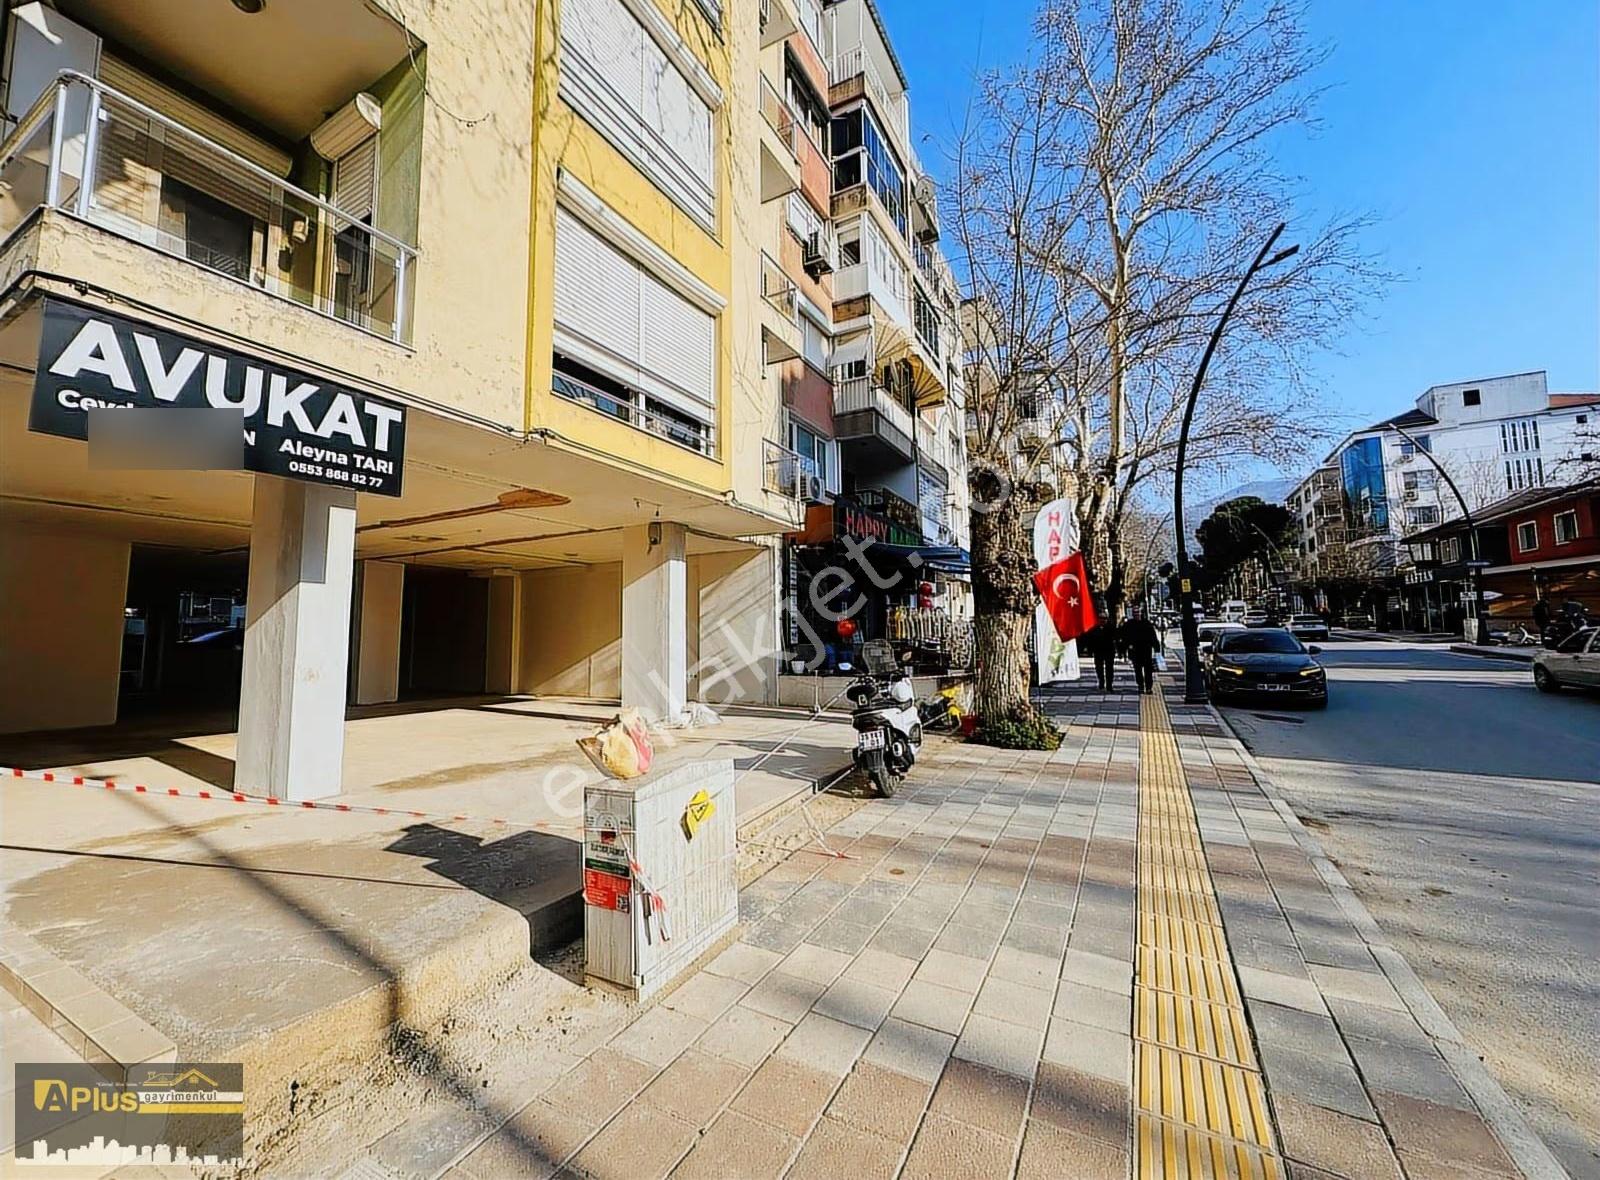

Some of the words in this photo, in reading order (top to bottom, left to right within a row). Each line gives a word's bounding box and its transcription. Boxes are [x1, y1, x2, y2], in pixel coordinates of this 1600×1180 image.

[48, 318, 402, 452] AVUKAT
[279, 438, 348, 466] Aleyna
[353, 453, 393, 475] TARI
[289, 461, 323, 476] 0553
[351, 473, 367, 485] 82
[369, 476, 383, 488] 77
[845, 506, 888, 545] HAPPY
